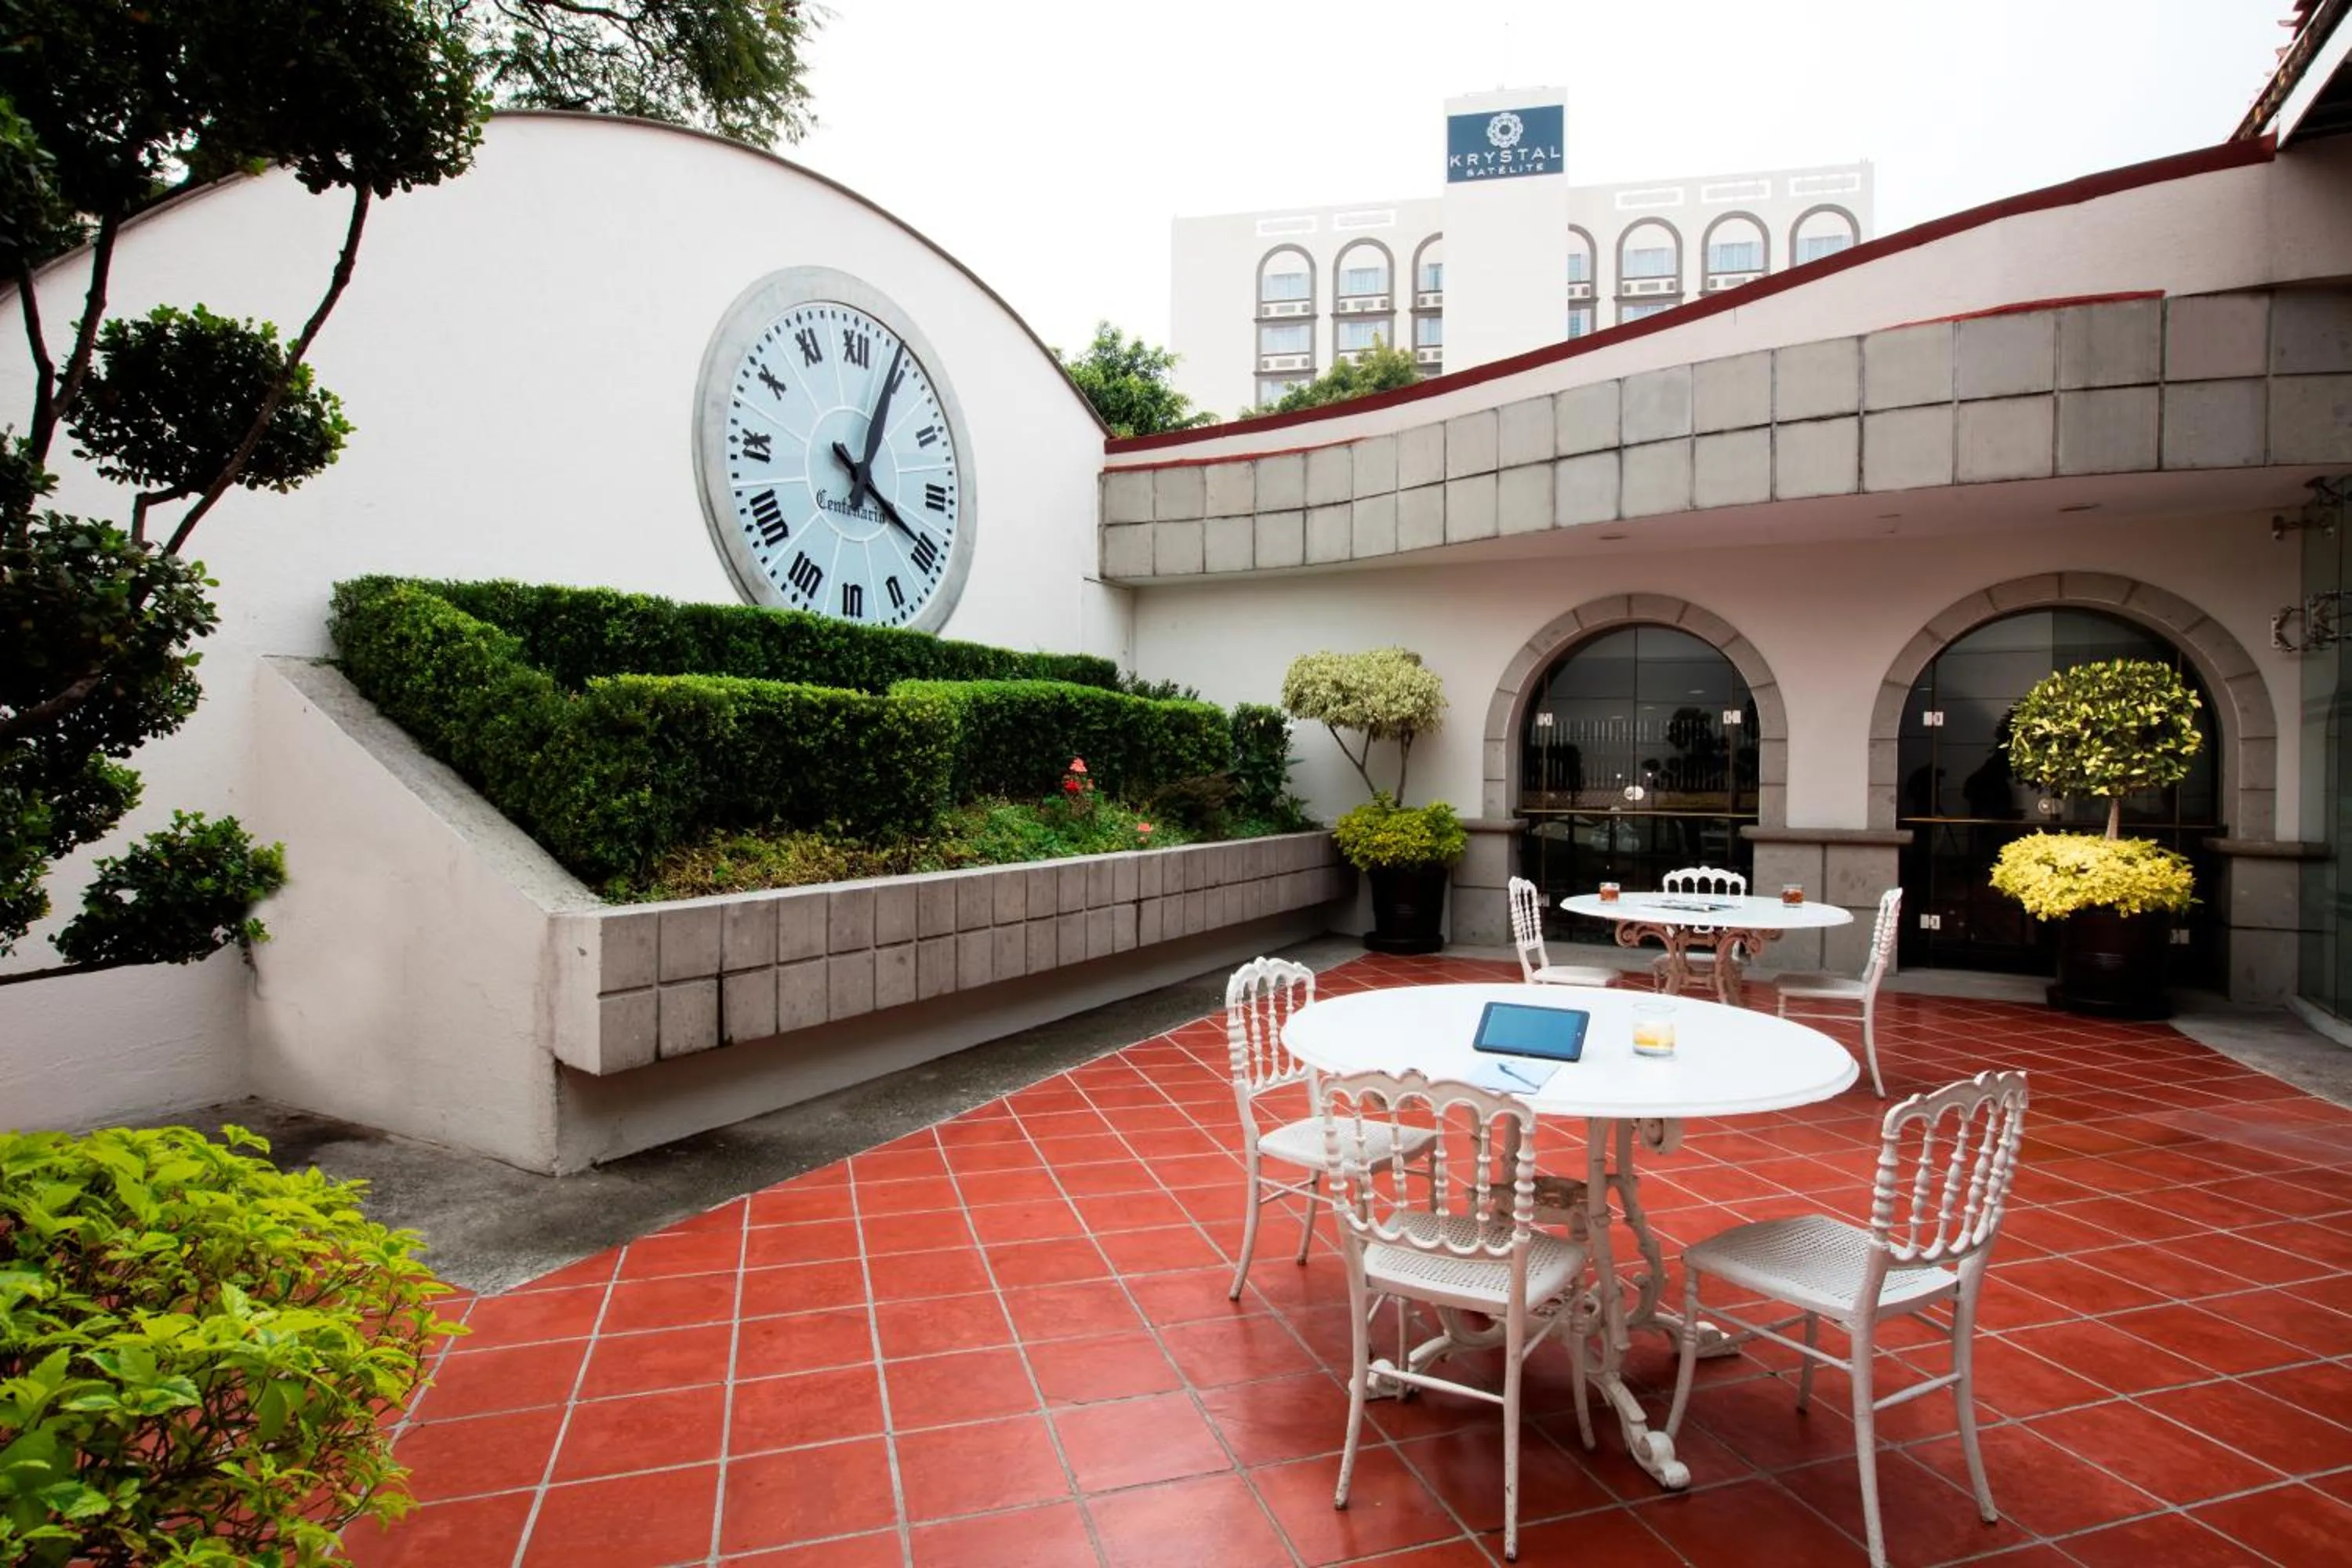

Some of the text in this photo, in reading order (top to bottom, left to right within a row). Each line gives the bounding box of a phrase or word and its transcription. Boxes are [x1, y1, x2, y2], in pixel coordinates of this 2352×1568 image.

[1450, 145, 1561, 167] KRYSTAL
[795, 327, 822, 368] XI
[844, 328, 869, 370] XII
[757, 363, 786, 401] X
